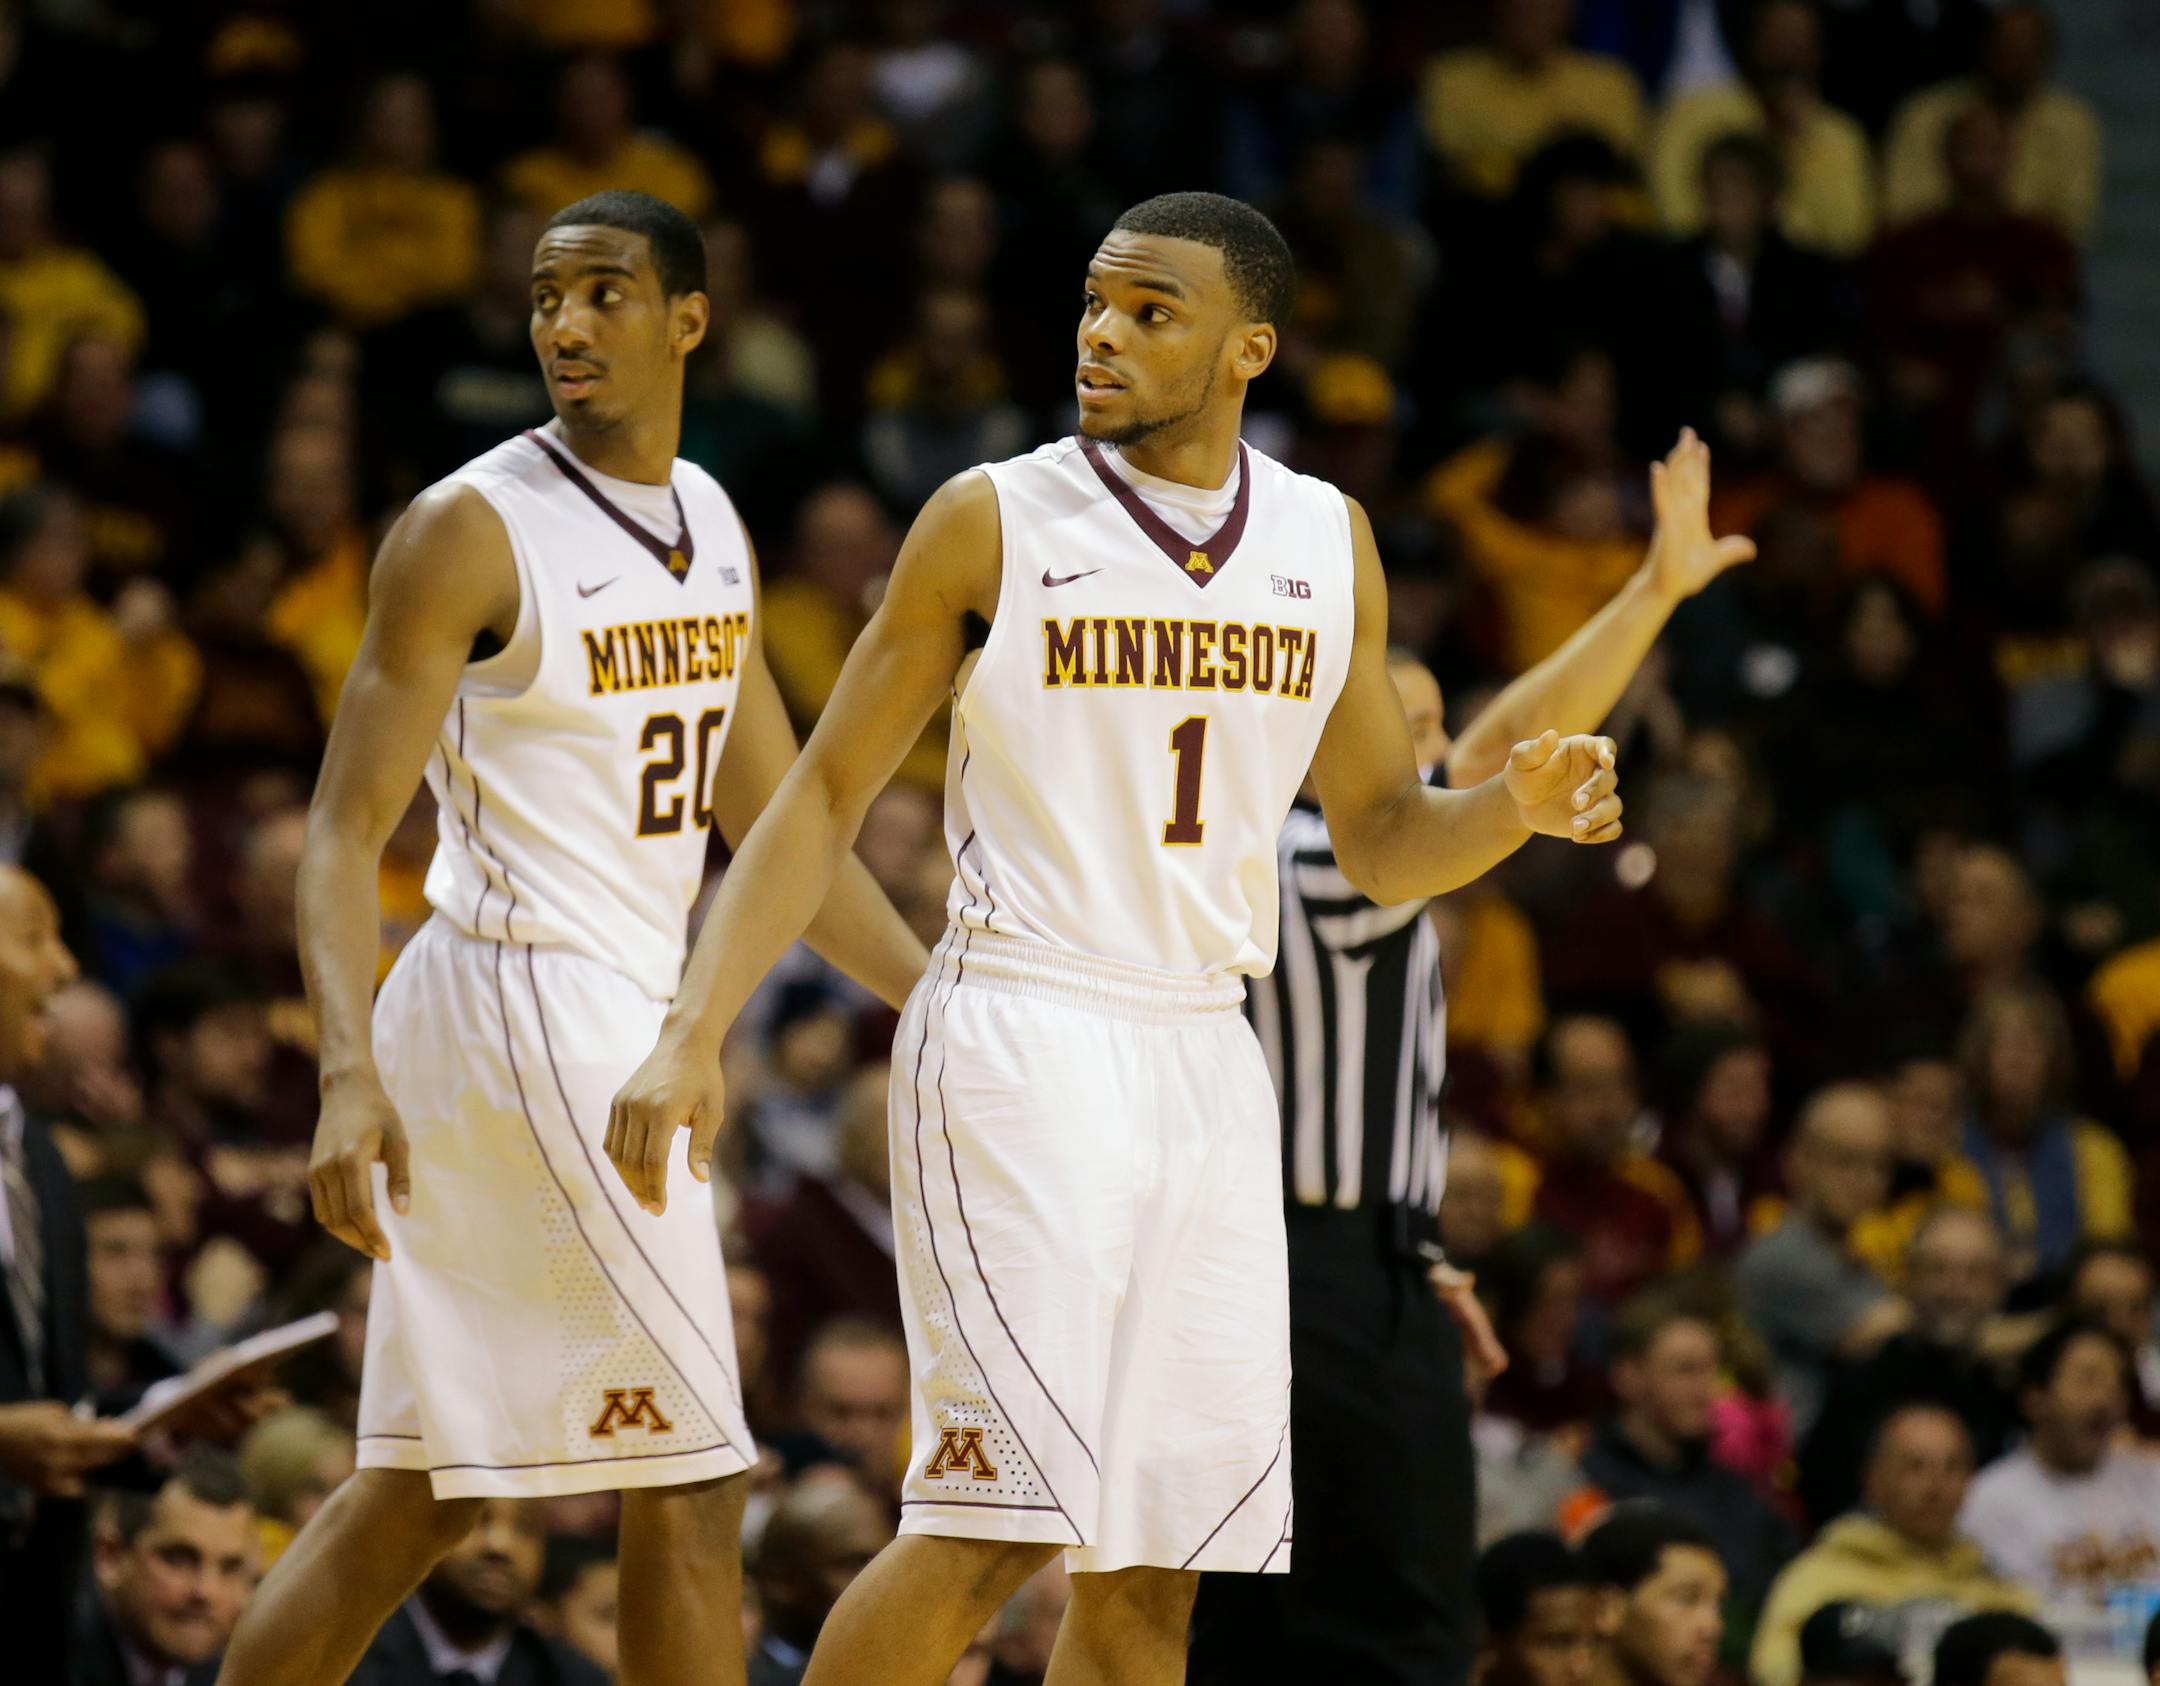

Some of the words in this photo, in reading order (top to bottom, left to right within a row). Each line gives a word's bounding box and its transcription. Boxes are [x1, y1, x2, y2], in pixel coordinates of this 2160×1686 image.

[1042, 616, 1318, 701] MINNESOTA
[1161, 714, 1210, 847] 1
[590, 1387, 673, 1438] M
[924, 1427, 998, 1481] M
